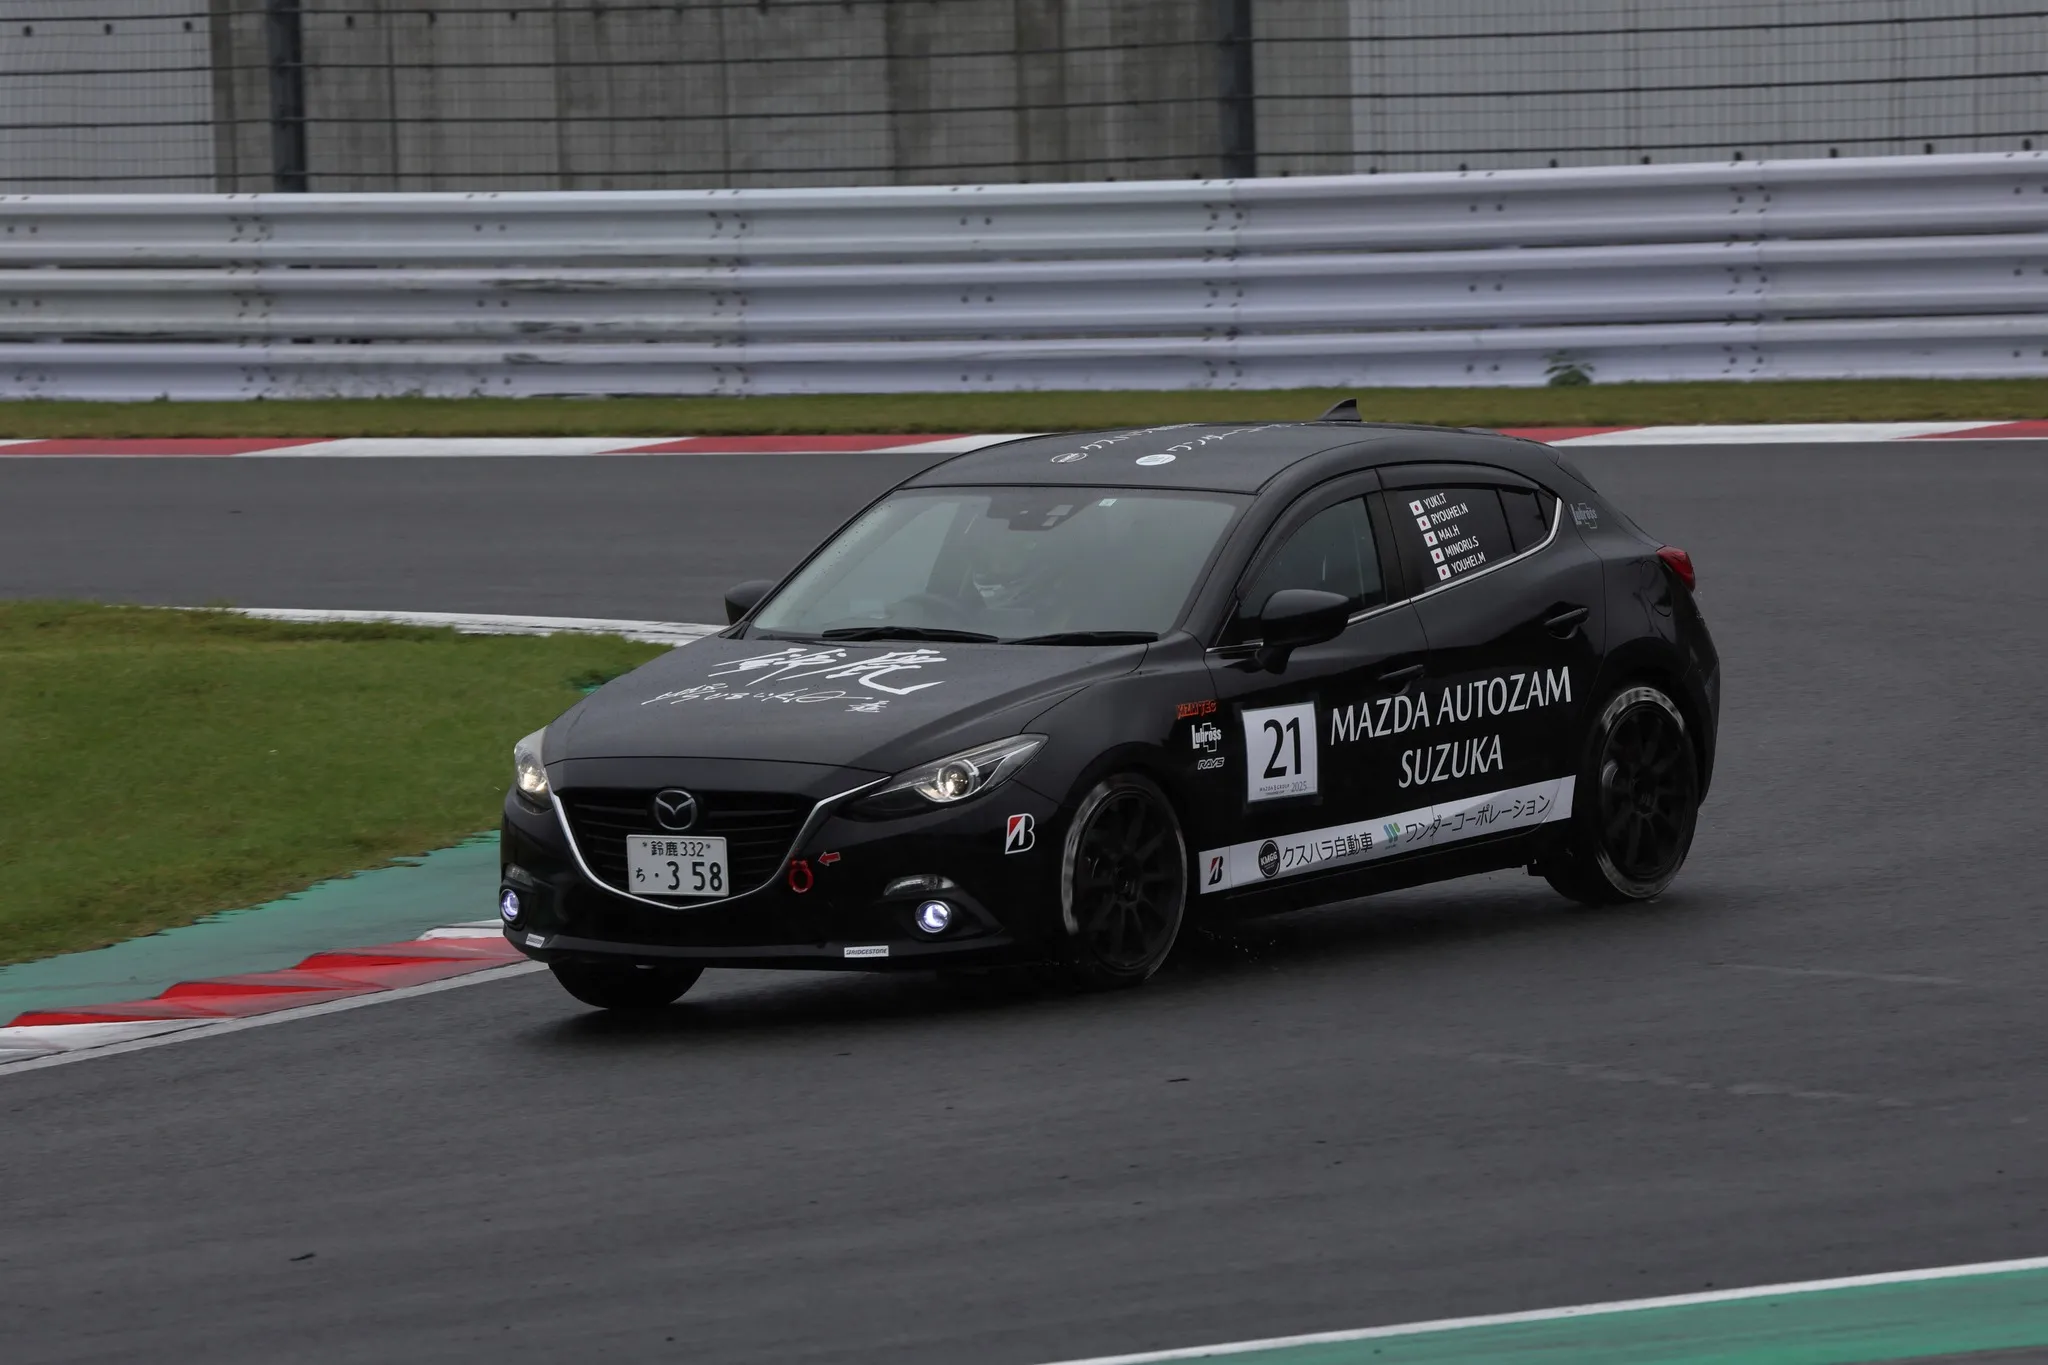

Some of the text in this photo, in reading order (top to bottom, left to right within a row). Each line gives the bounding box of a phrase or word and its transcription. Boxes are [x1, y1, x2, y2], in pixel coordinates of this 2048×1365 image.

[1422, 492, 1448, 510] YUKI.T
[1430, 502, 1469, 526] RYOUHEI.N
[1437, 524, 1461, 542] MAI.H
[1444, 535, 1480, 558] MINORU.S
[1450, 551, 1487, 574] YOUHEI.M
[1330, 666, 1572, 746] MAZDA AUTOZAM
[1191, 723, 1222, 750] Lubross
[1263, 717, 1302, 779] 21
[1197, 756, 1225, 771] RAYS
[1398, 734, 1504, 789] SUZUKA
[1291, 781, 1307, 792] 2025
[1405, 795, 1550, 842] ワンダーコーポレーション
[1282, 832, 1373, 868] クスハラ自動車
[635, 867, 646, 882] ち
[846, 948, 887, 956] BRIDGESTONE
